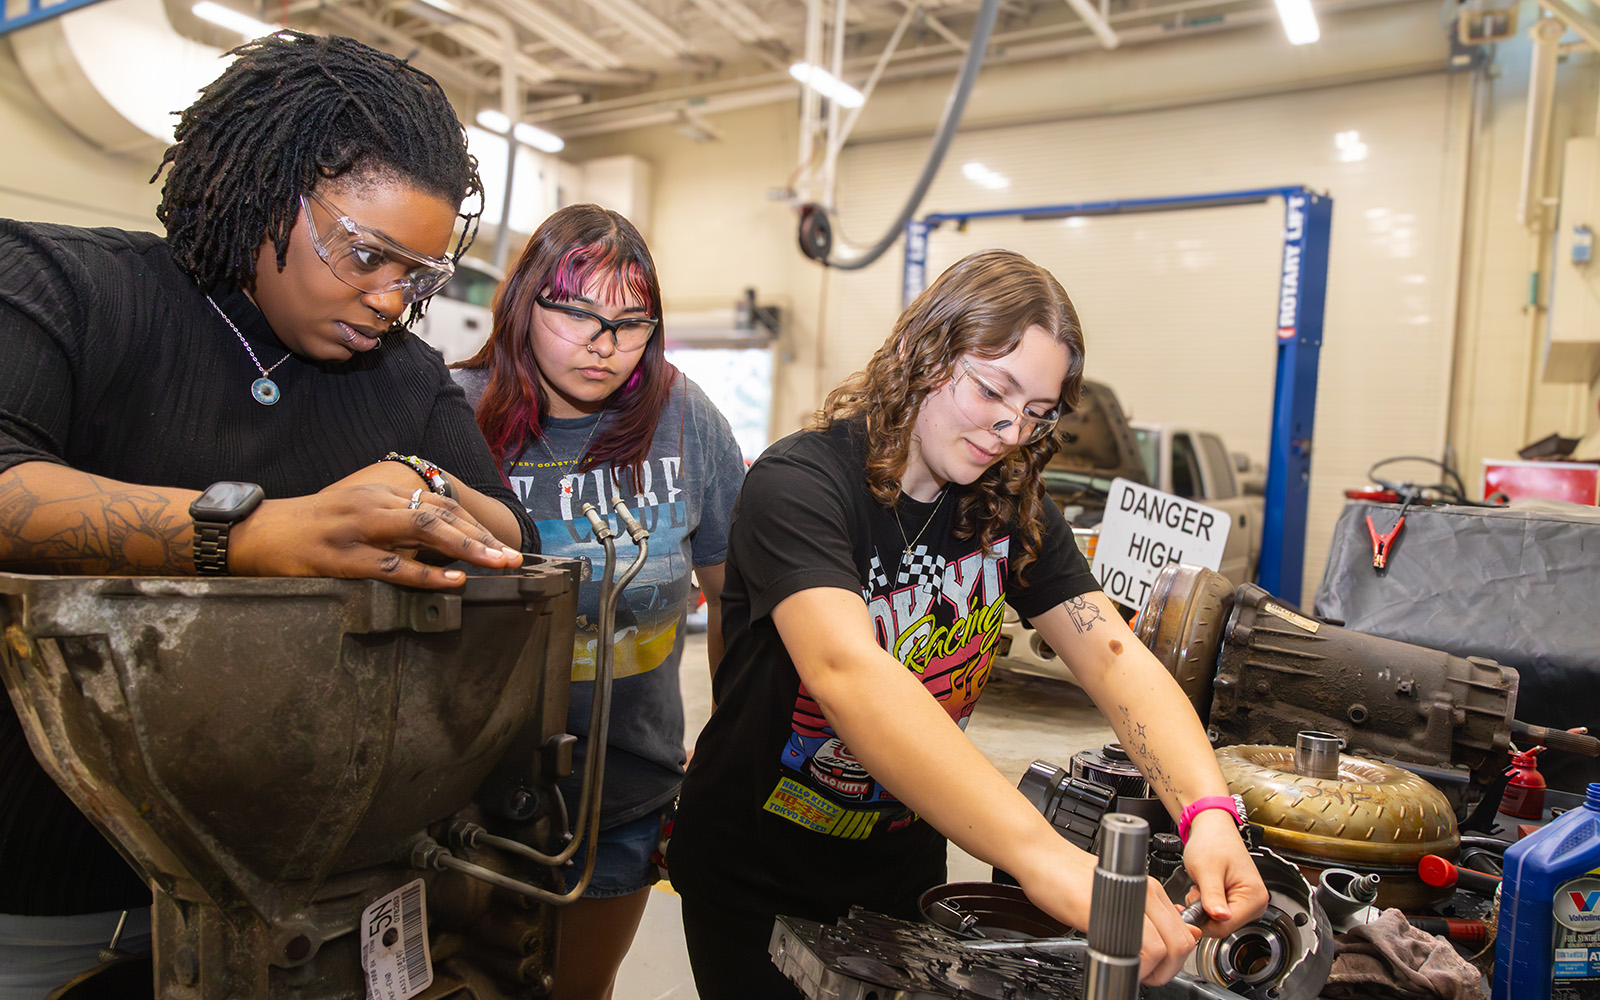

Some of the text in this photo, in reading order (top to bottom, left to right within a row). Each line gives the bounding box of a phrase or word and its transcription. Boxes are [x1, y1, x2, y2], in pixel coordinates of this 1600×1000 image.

[1279, 195, 1305, 327] ROTARY LIFT
[1120, 486, 1215, 541] DANGER
[1128, 533, 1183, 568] HIGH
[1101, 563, 1151, 606] VOLT
[894, 592, 1006, 674] Racing
[782, 780, 810, 797] HELLO
[811, 795, 839, 814] KITTY
[810, 765, 868, 792] HELLO KITTY
[769, 803, 798, 819] TOKYO
[798, 815, 827, 832] SPEED
[369, 899, 392, 938] 5N
